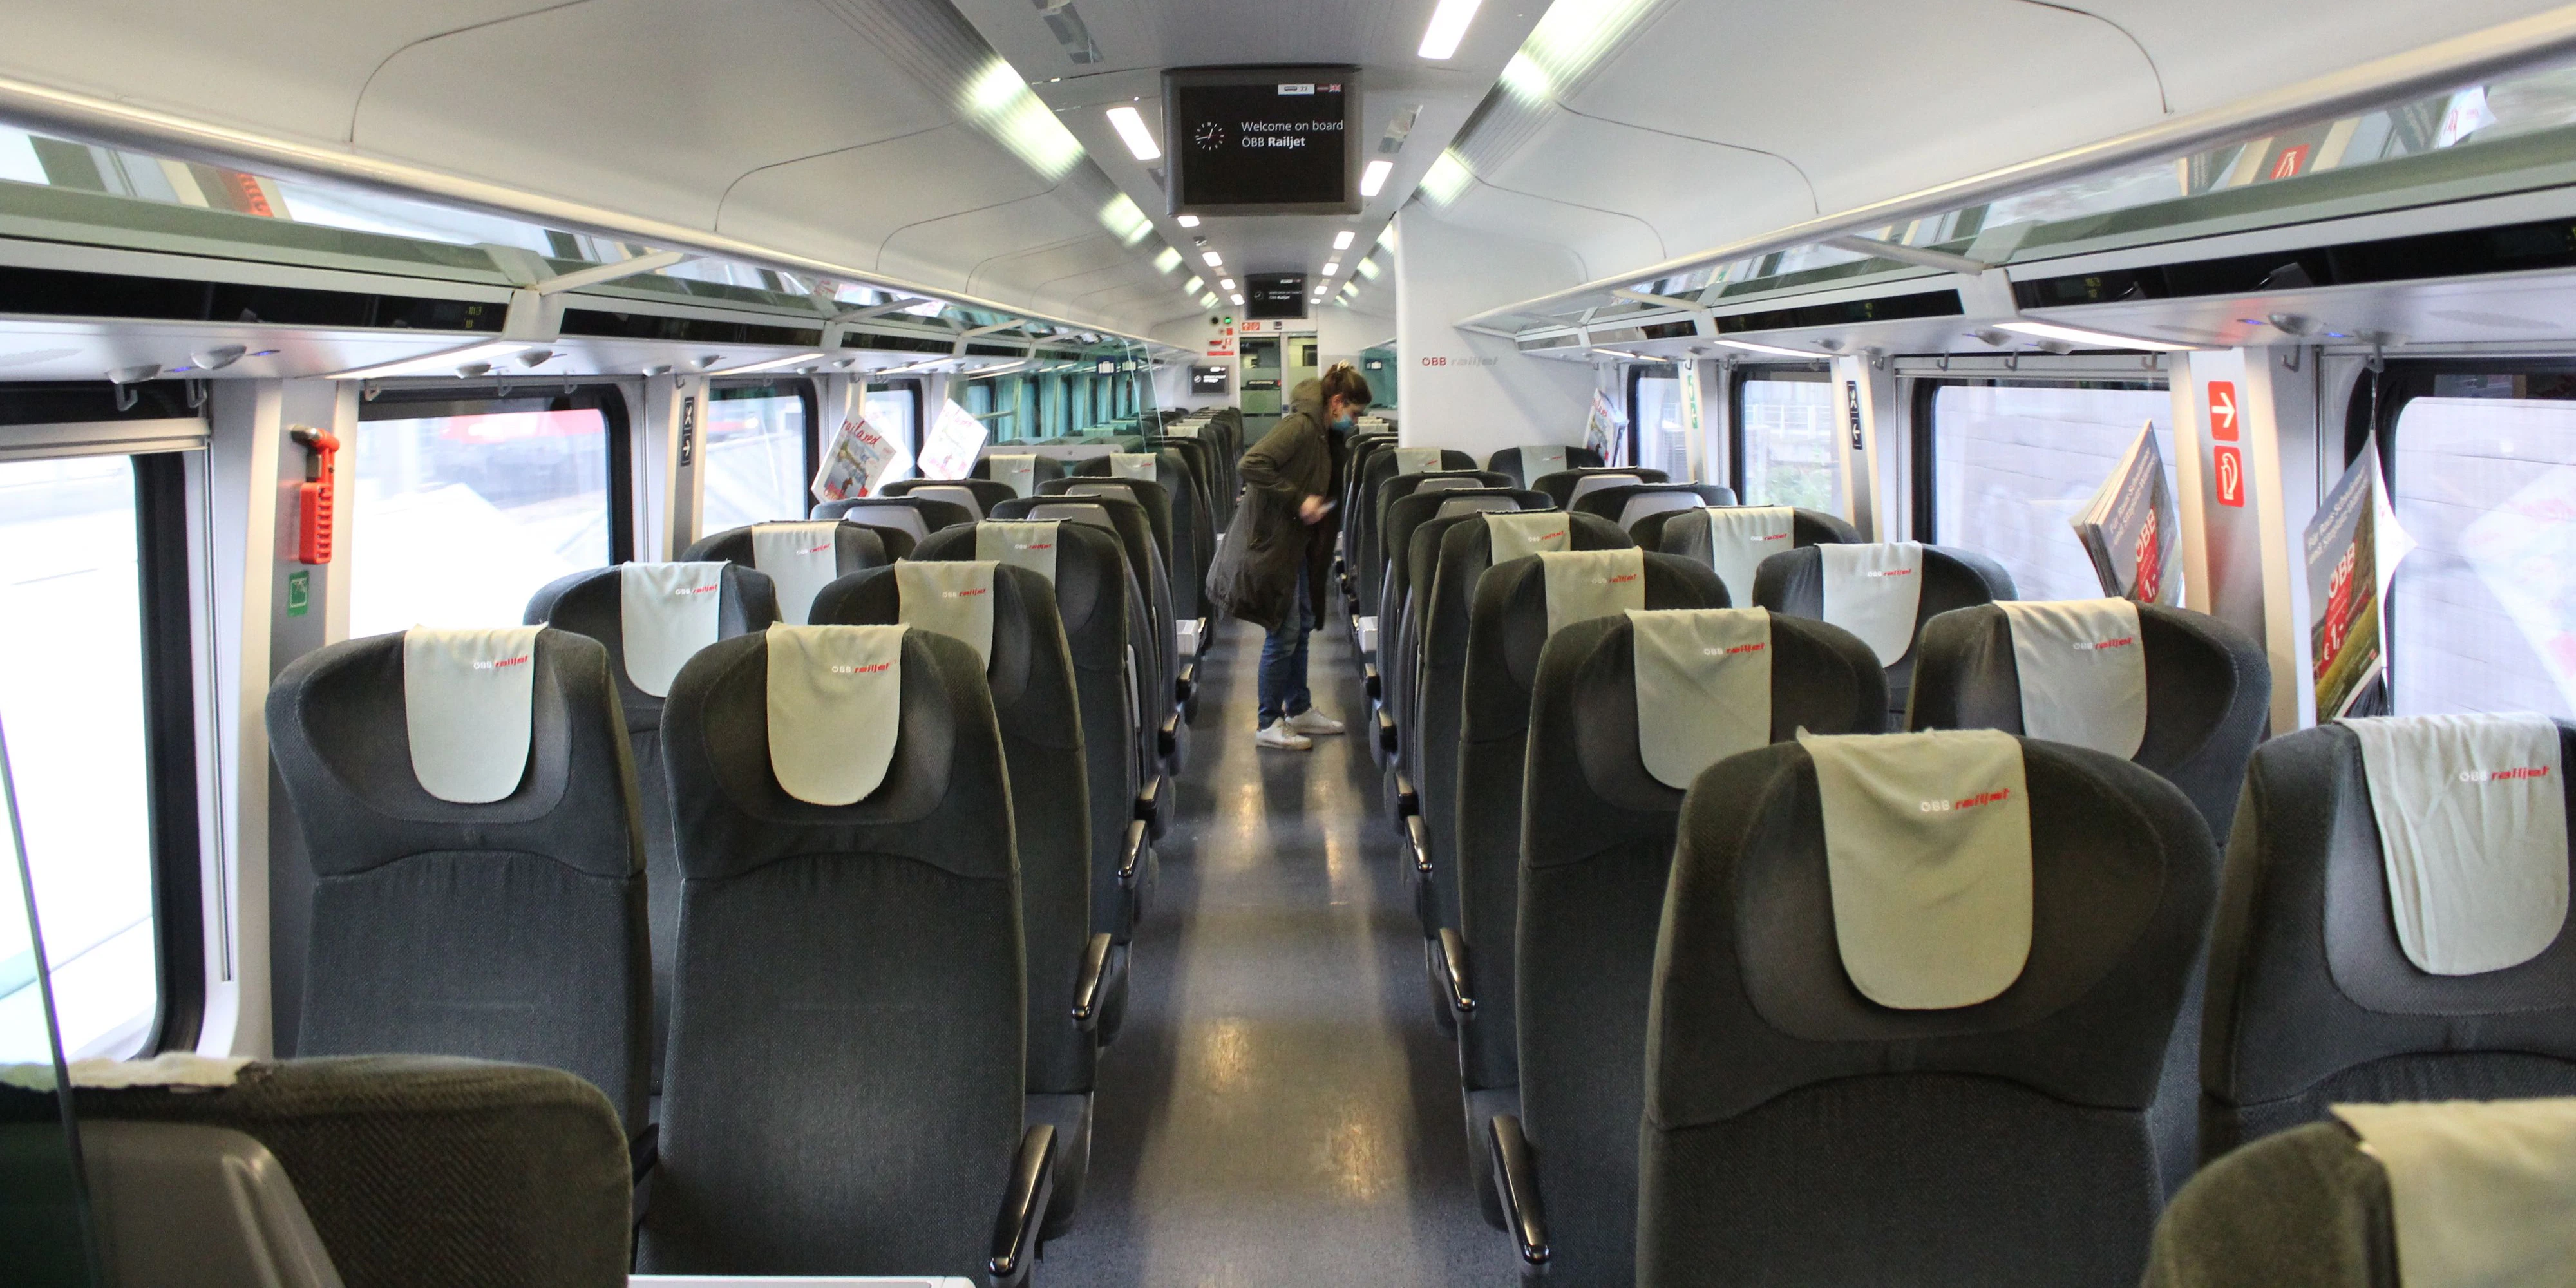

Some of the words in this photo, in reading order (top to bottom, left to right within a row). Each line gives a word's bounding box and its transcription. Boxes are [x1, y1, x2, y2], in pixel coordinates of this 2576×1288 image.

[1241, 121, 1292, 131] Welcome
[1294, 122, 1309, 131] on
[1312, 120, 1343, 131] board
[1242, 135, 1265, 147] ÖBB
[1267, 136, 1306, 149] Railjet
[1450, 356, 1499, 368] railjet
[2329, 542, 2356, 598] ÖBB
